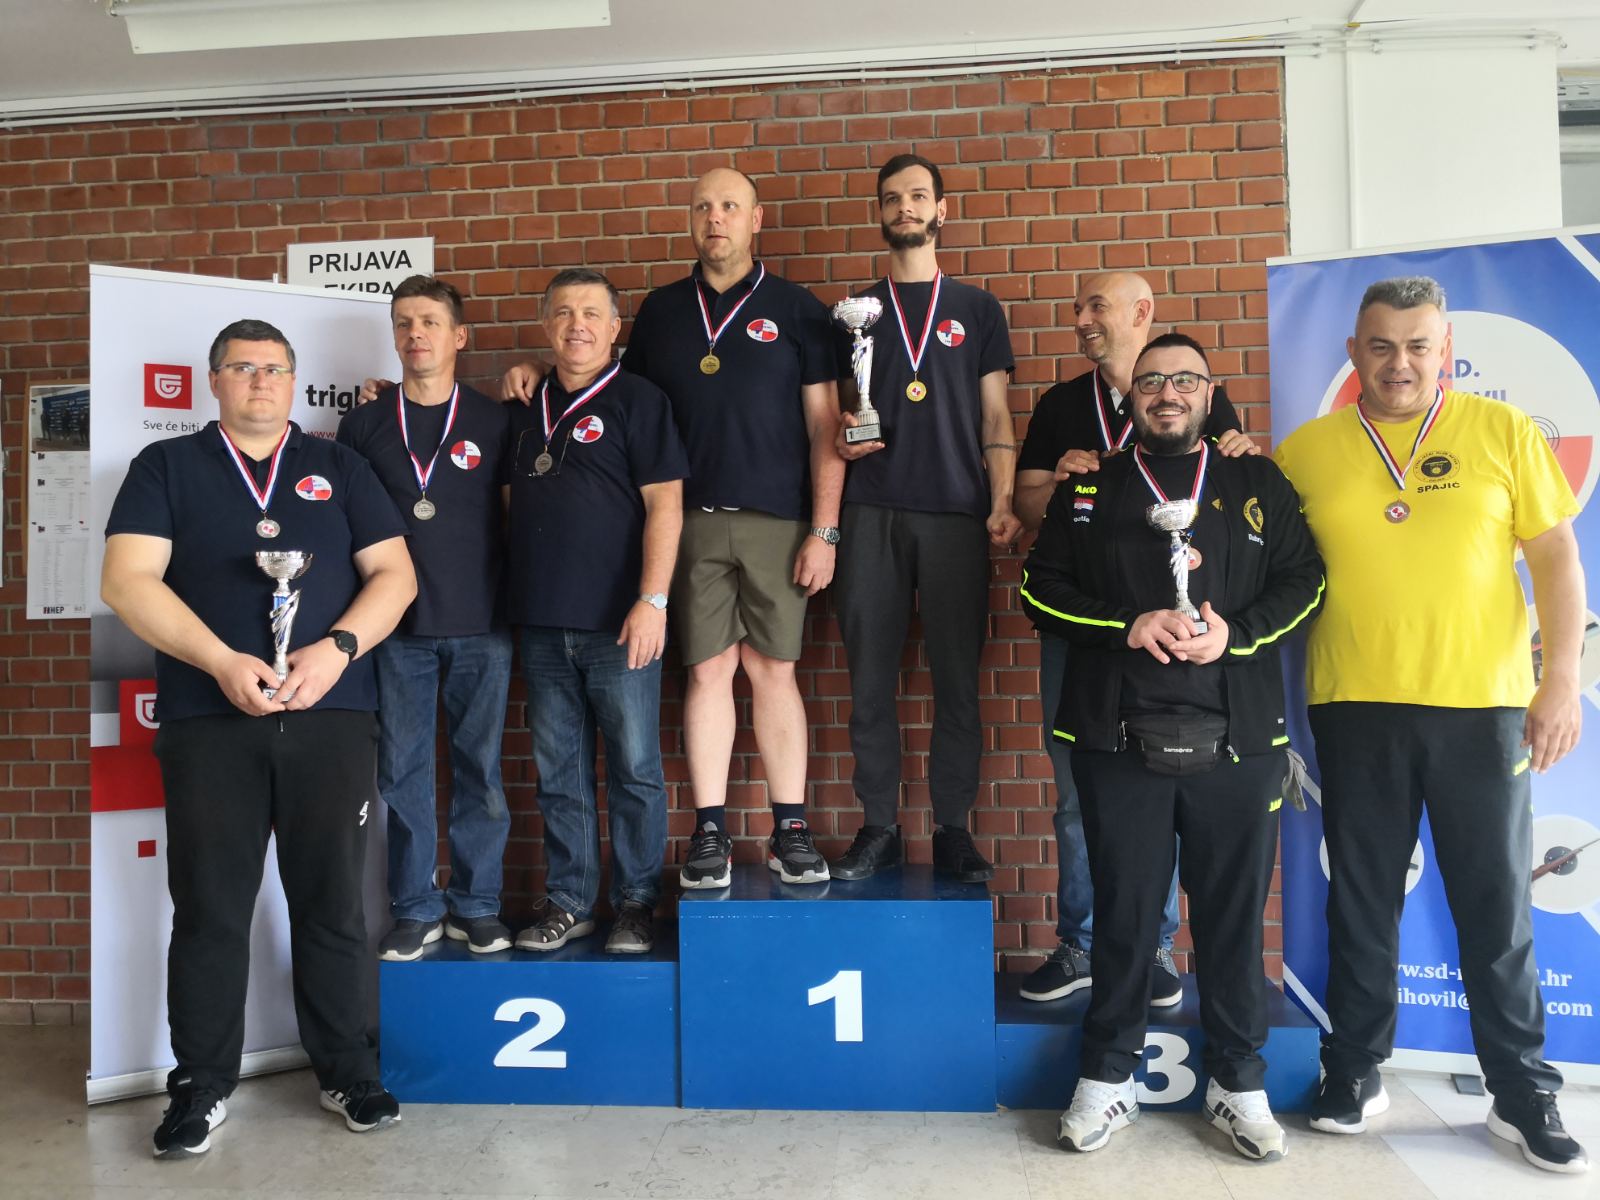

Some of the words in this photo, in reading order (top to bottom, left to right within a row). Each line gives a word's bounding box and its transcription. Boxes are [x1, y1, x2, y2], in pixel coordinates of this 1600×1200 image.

[309, 249, 412, 274] PRIJAVA
[143, 420, 163, 430] Sve
[181, 421, 200, 433] biti
[848, 430, 853, 440] 1
[807, 970, 863, 1042] 1
[1546, 1001, 1594, 1017] com
[493, 997, 567, 1069] 2
[1133, 1032, 1197, 1105] 3
